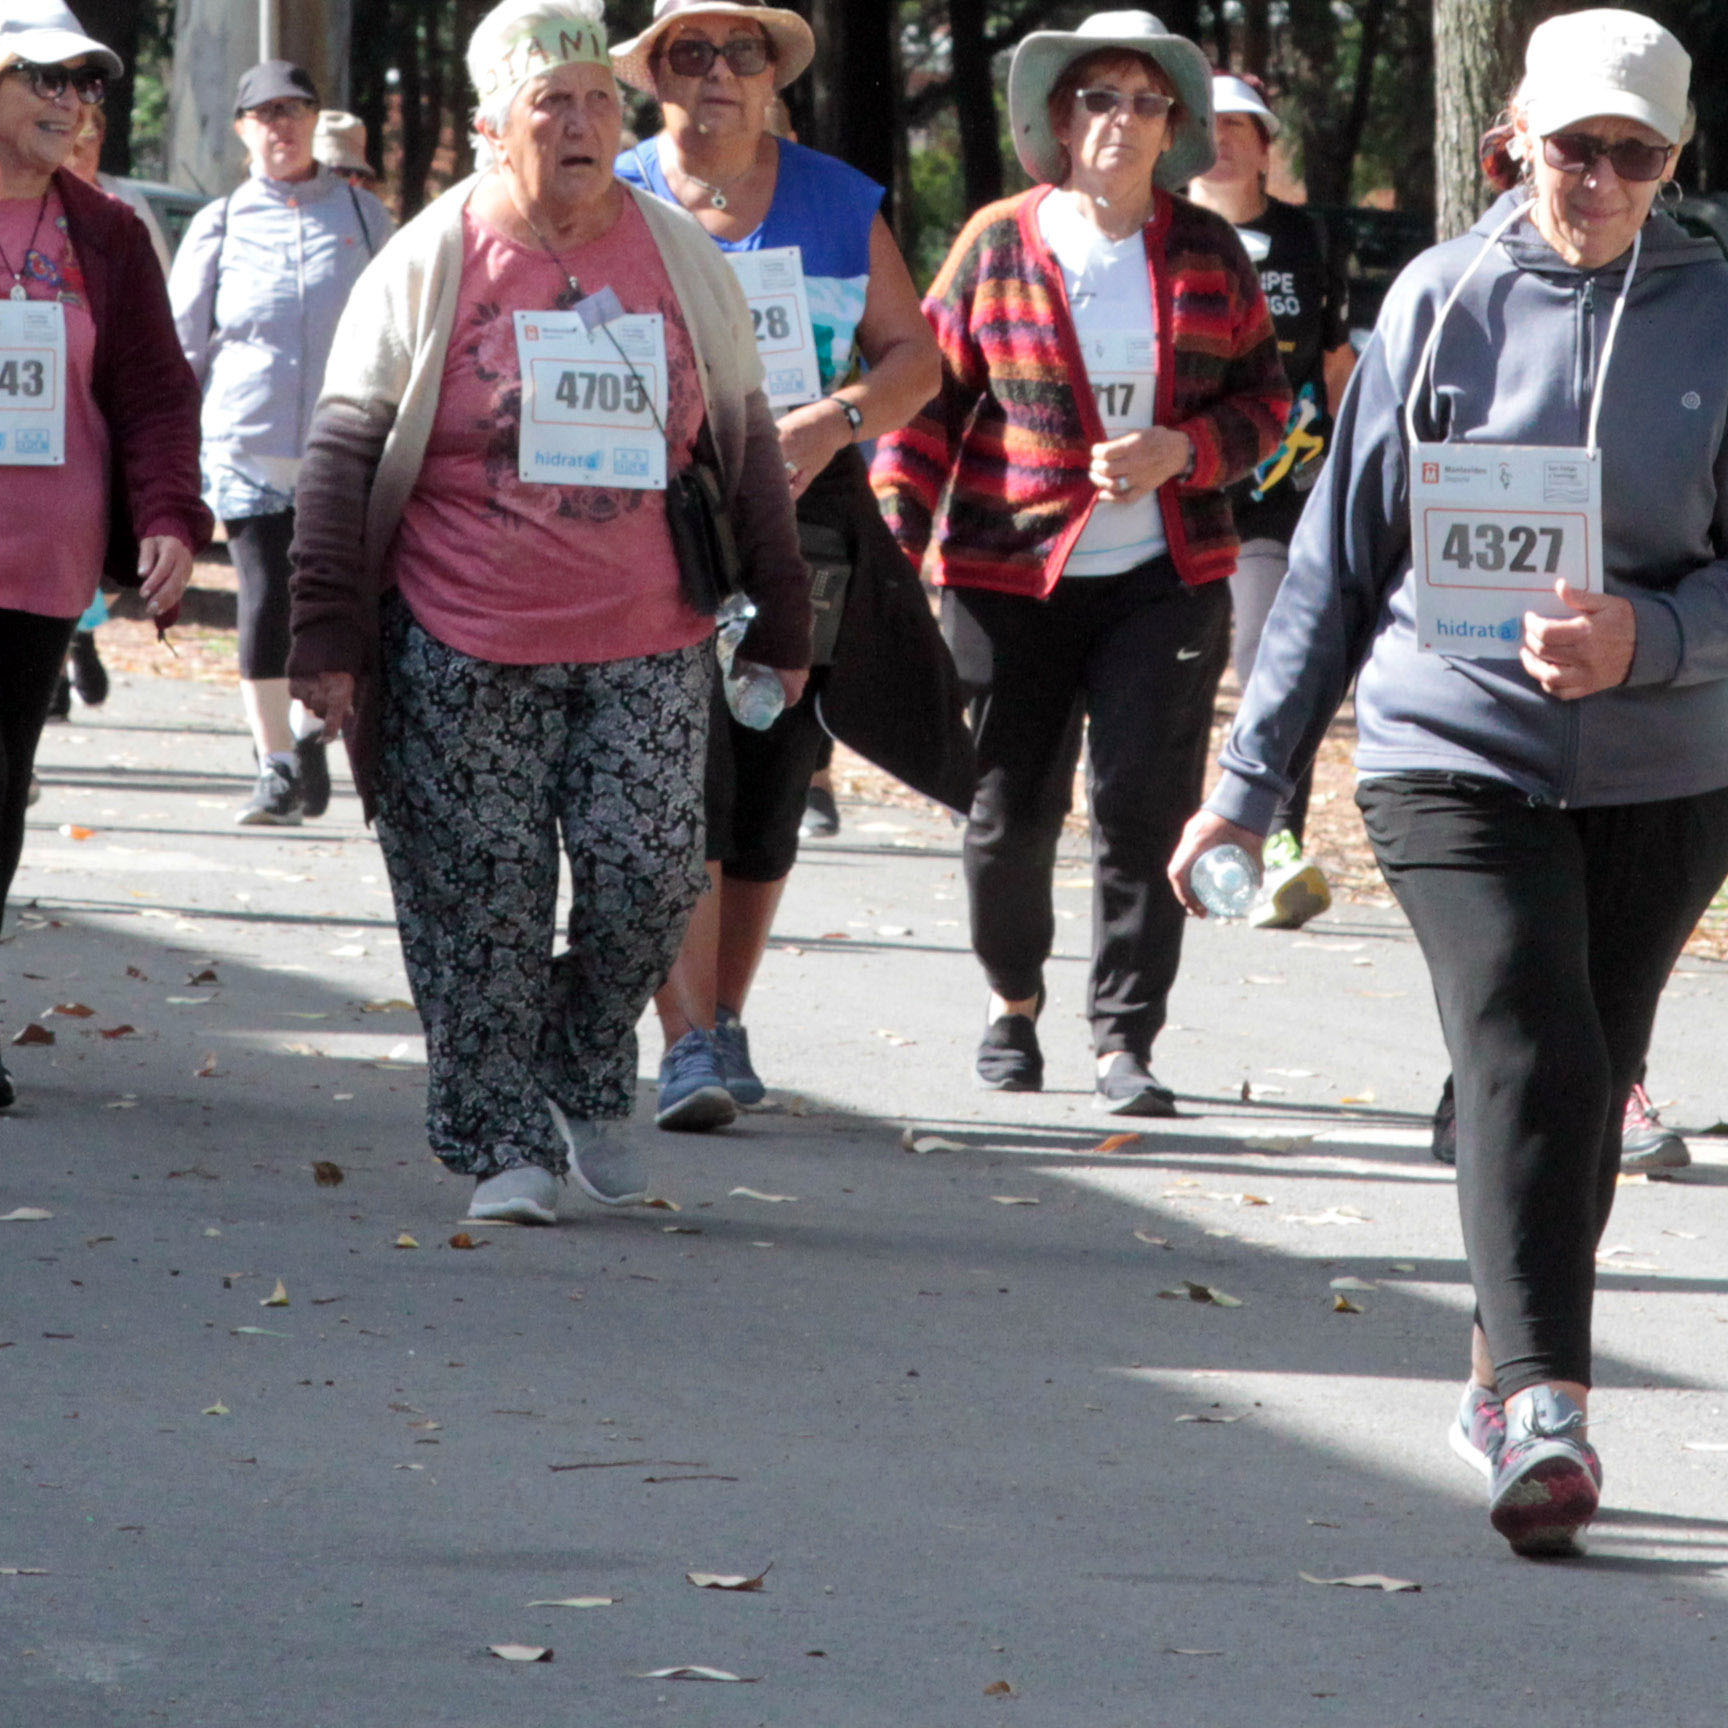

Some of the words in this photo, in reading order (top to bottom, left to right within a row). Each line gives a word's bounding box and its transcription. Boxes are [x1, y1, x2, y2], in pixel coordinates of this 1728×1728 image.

[555, 370, 648, 414] 4705
[1441, 523, 1564, 574] 4327
[1436, 618, 1520, 643] hidrata
